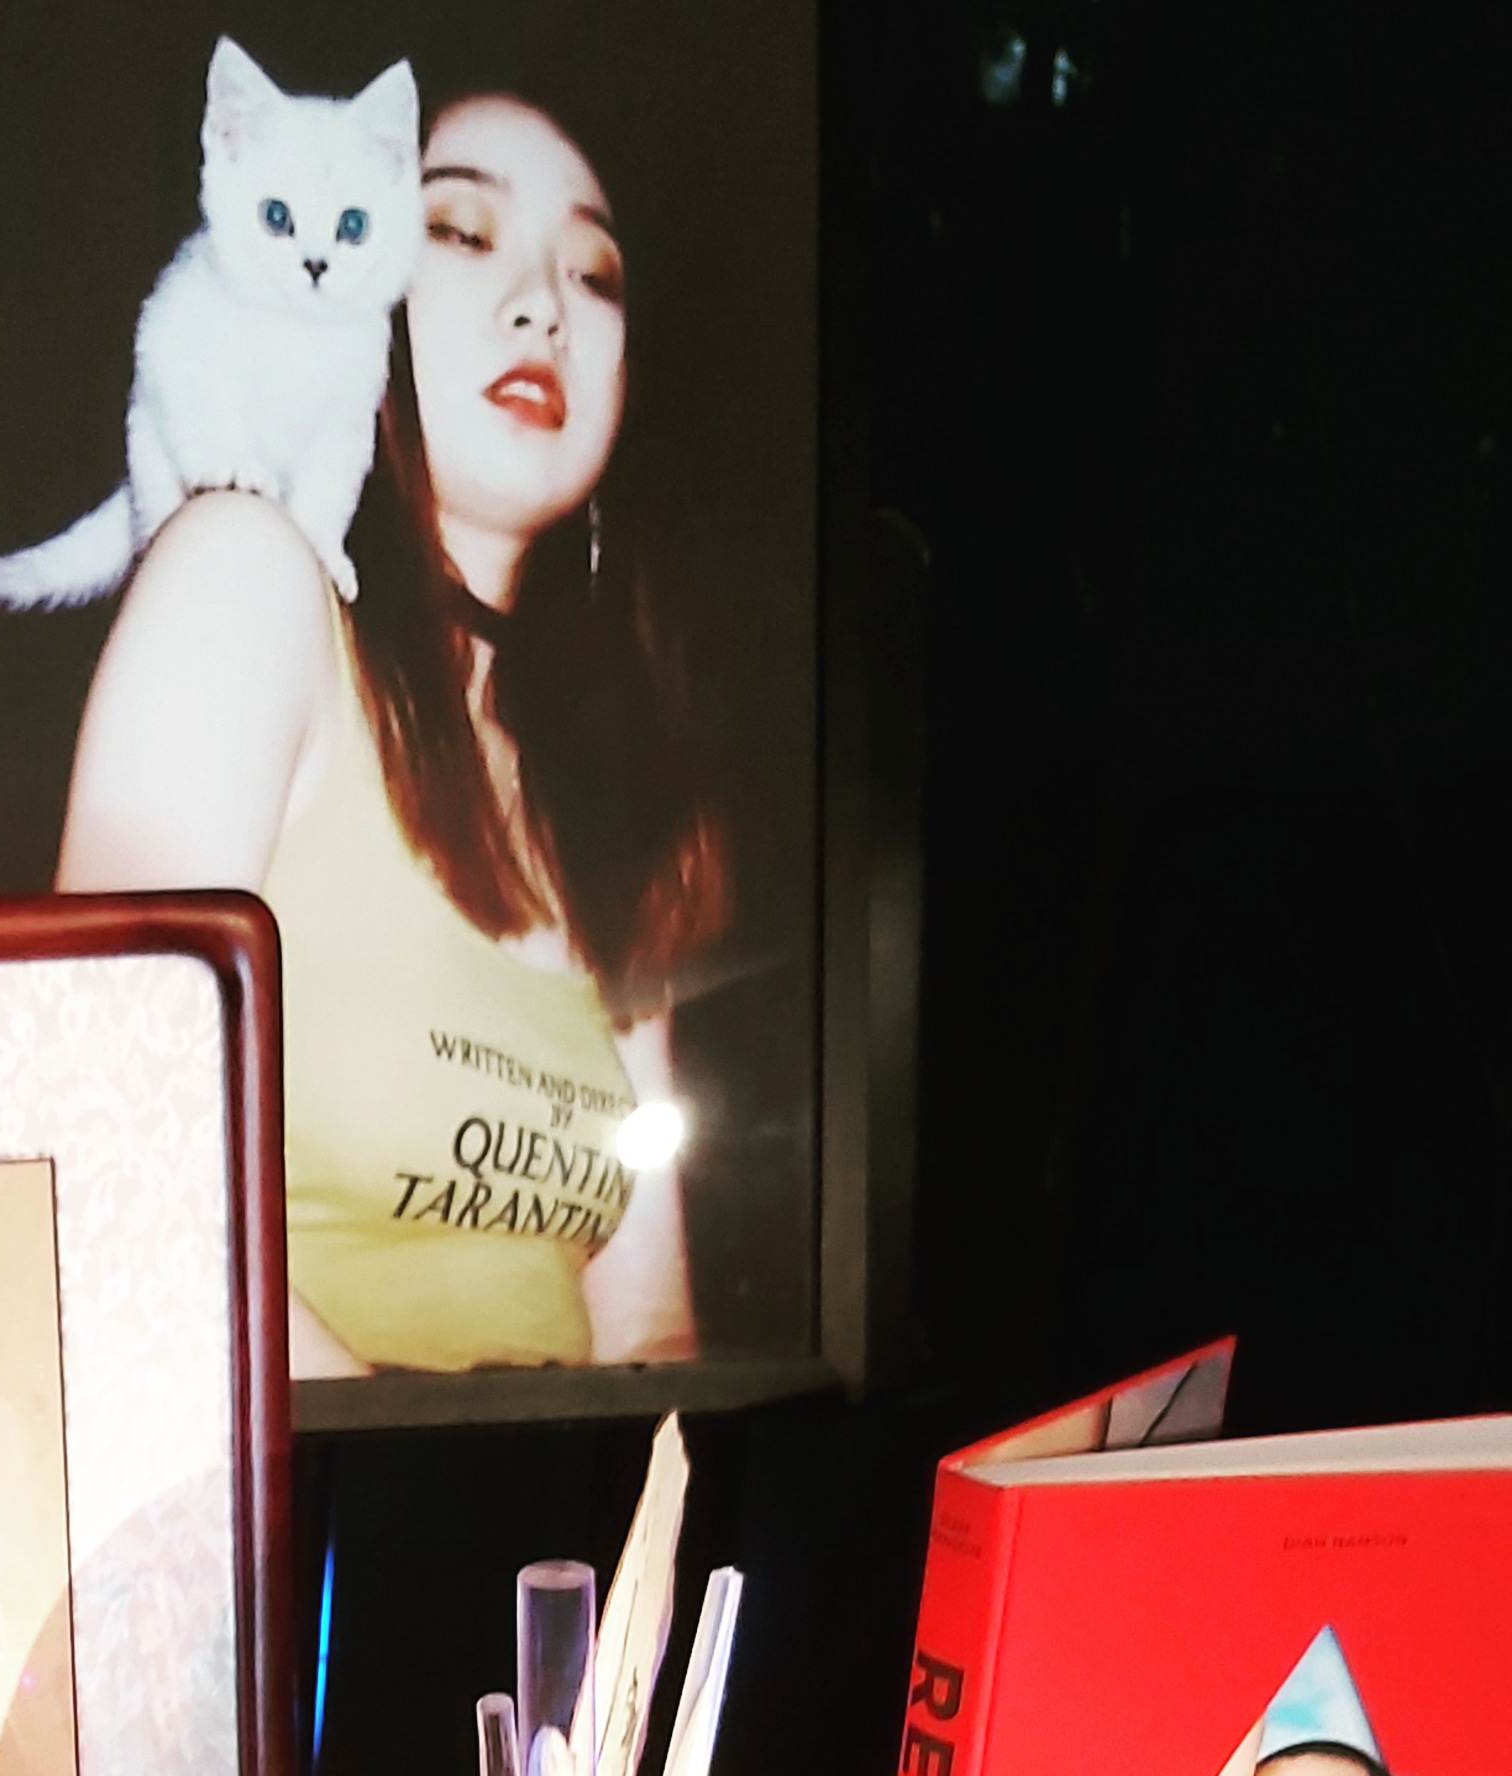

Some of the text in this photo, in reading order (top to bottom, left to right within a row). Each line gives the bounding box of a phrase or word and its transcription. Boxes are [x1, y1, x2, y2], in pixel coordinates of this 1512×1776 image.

[430, 1029, 533, 1089] WRITTEN
[537, 1071, 576, 1104] AND
[550, 1104, 573, 1129] BY
[453, 1117, 628, 1206] QUENTIN
